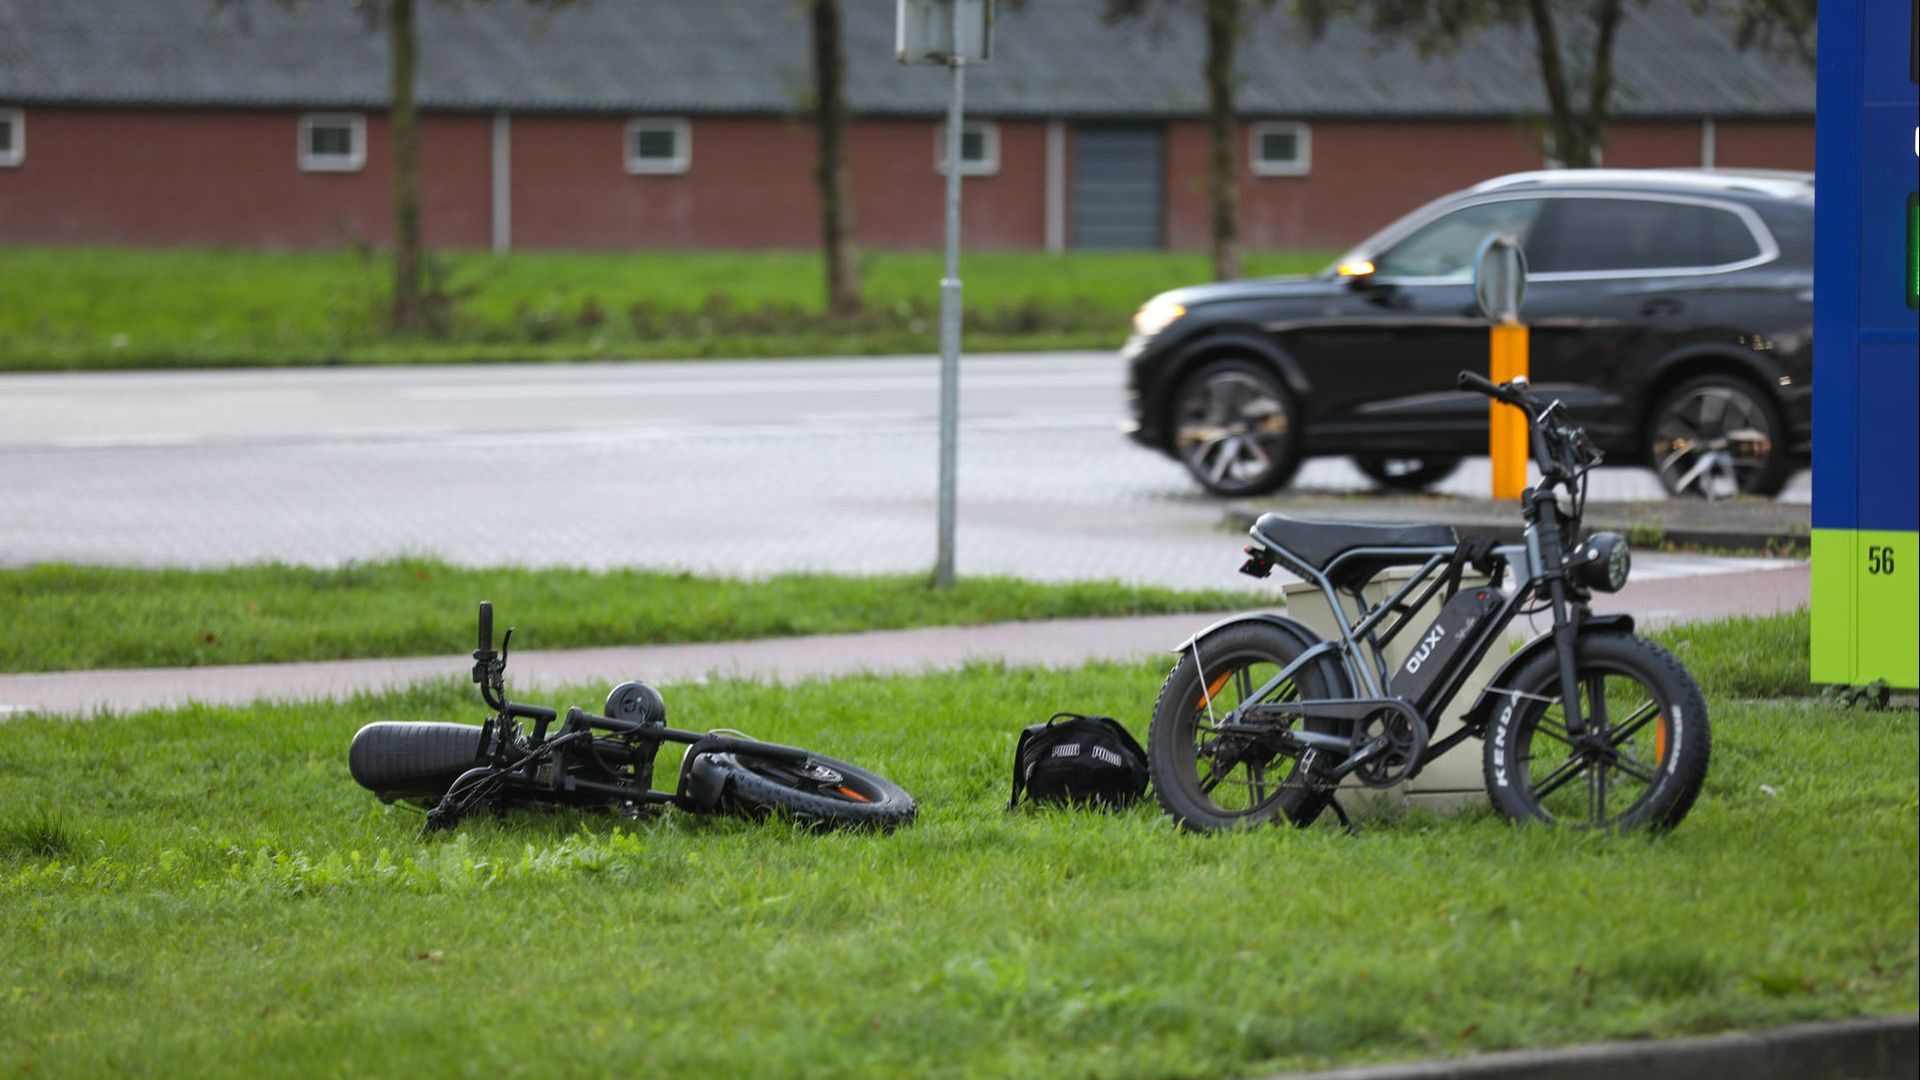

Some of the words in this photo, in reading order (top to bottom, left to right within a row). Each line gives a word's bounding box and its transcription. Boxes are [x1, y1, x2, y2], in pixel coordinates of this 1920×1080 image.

[1869, 546, 1894, 575] 56
[1406, 624, 1446, 674] OUXI
[1494, 690, 1522, 787] KENDA
